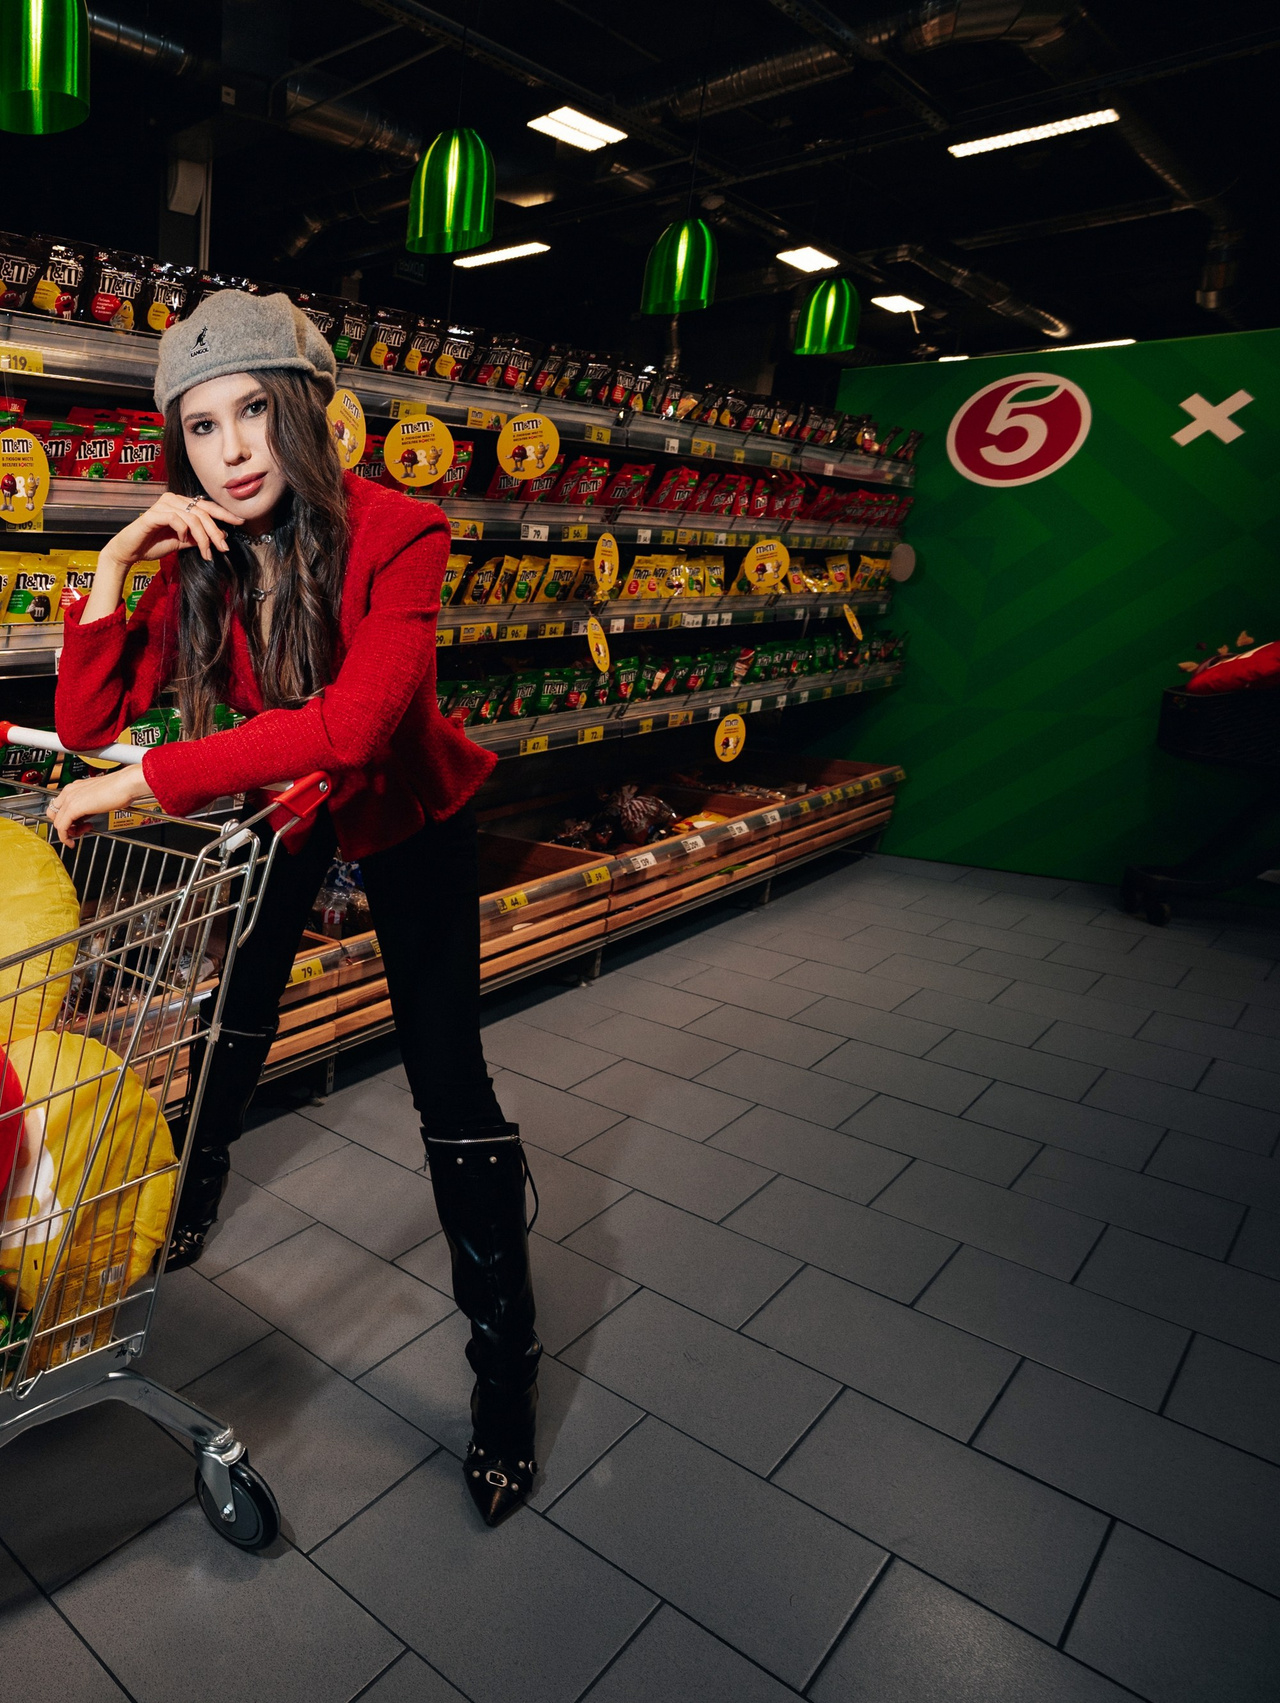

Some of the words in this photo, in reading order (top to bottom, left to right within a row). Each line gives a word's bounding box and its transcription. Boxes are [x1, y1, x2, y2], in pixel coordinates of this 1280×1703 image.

[401, 420, 434, 435] m&m's
[1, 437, 33, 454] m&m's
[302, 967, 312, 979] 79
